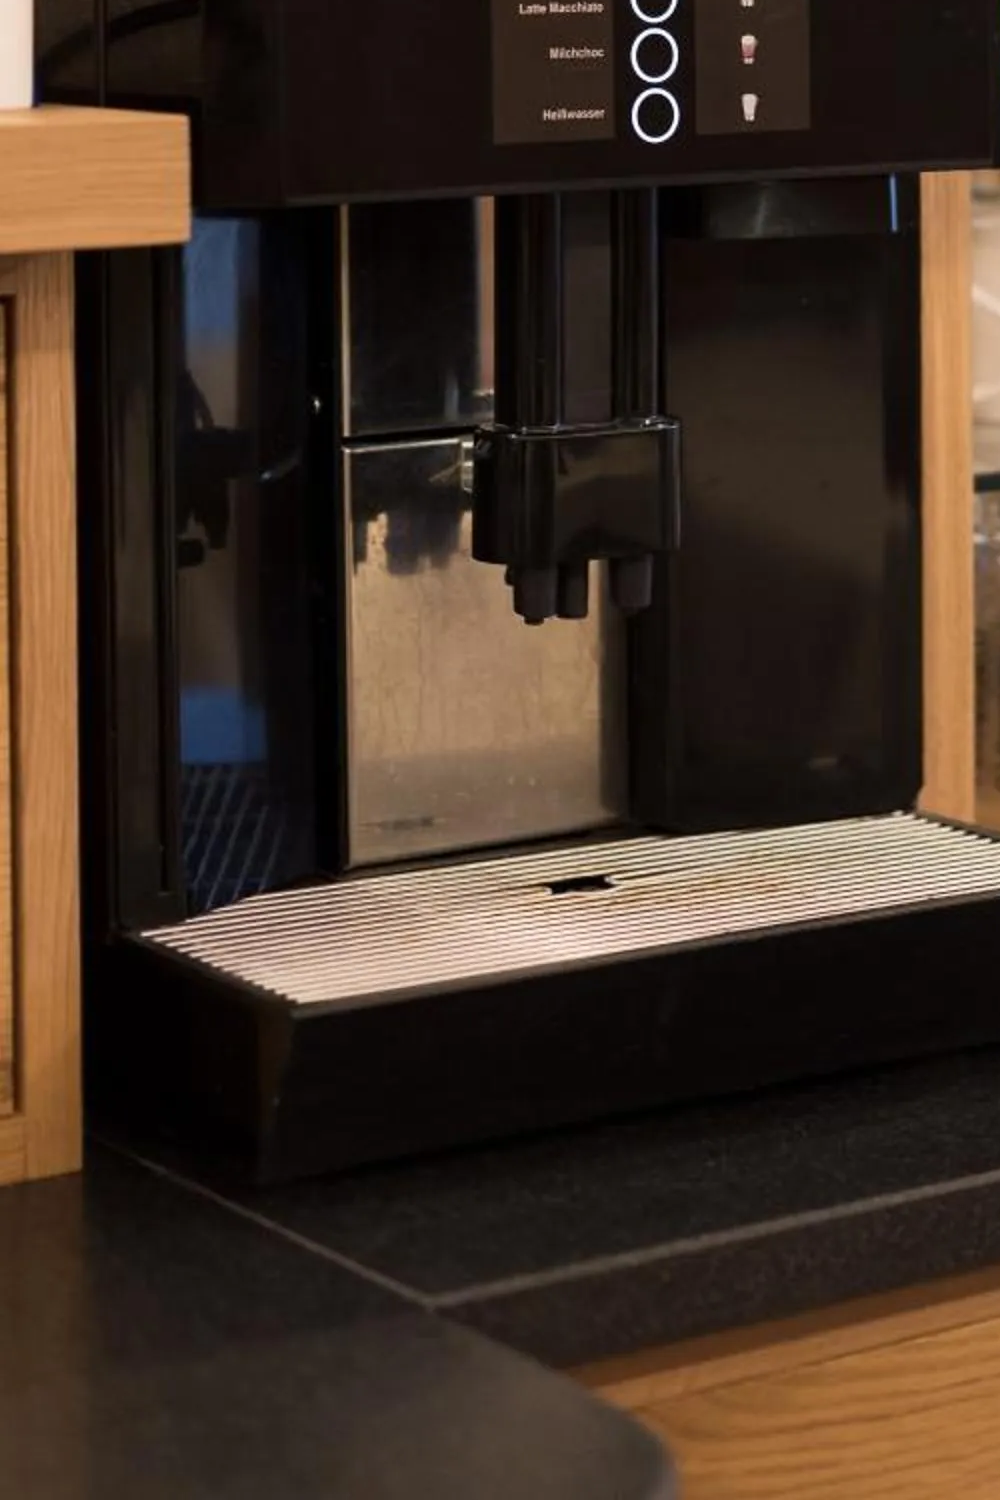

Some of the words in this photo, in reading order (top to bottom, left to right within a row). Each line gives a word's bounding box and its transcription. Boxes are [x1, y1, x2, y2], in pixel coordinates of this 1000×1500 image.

[518, 2, 547, 15] Latte
[549, 0, 604, 14] Macchiato
[549, 47, 605, 60] Milchchoc
